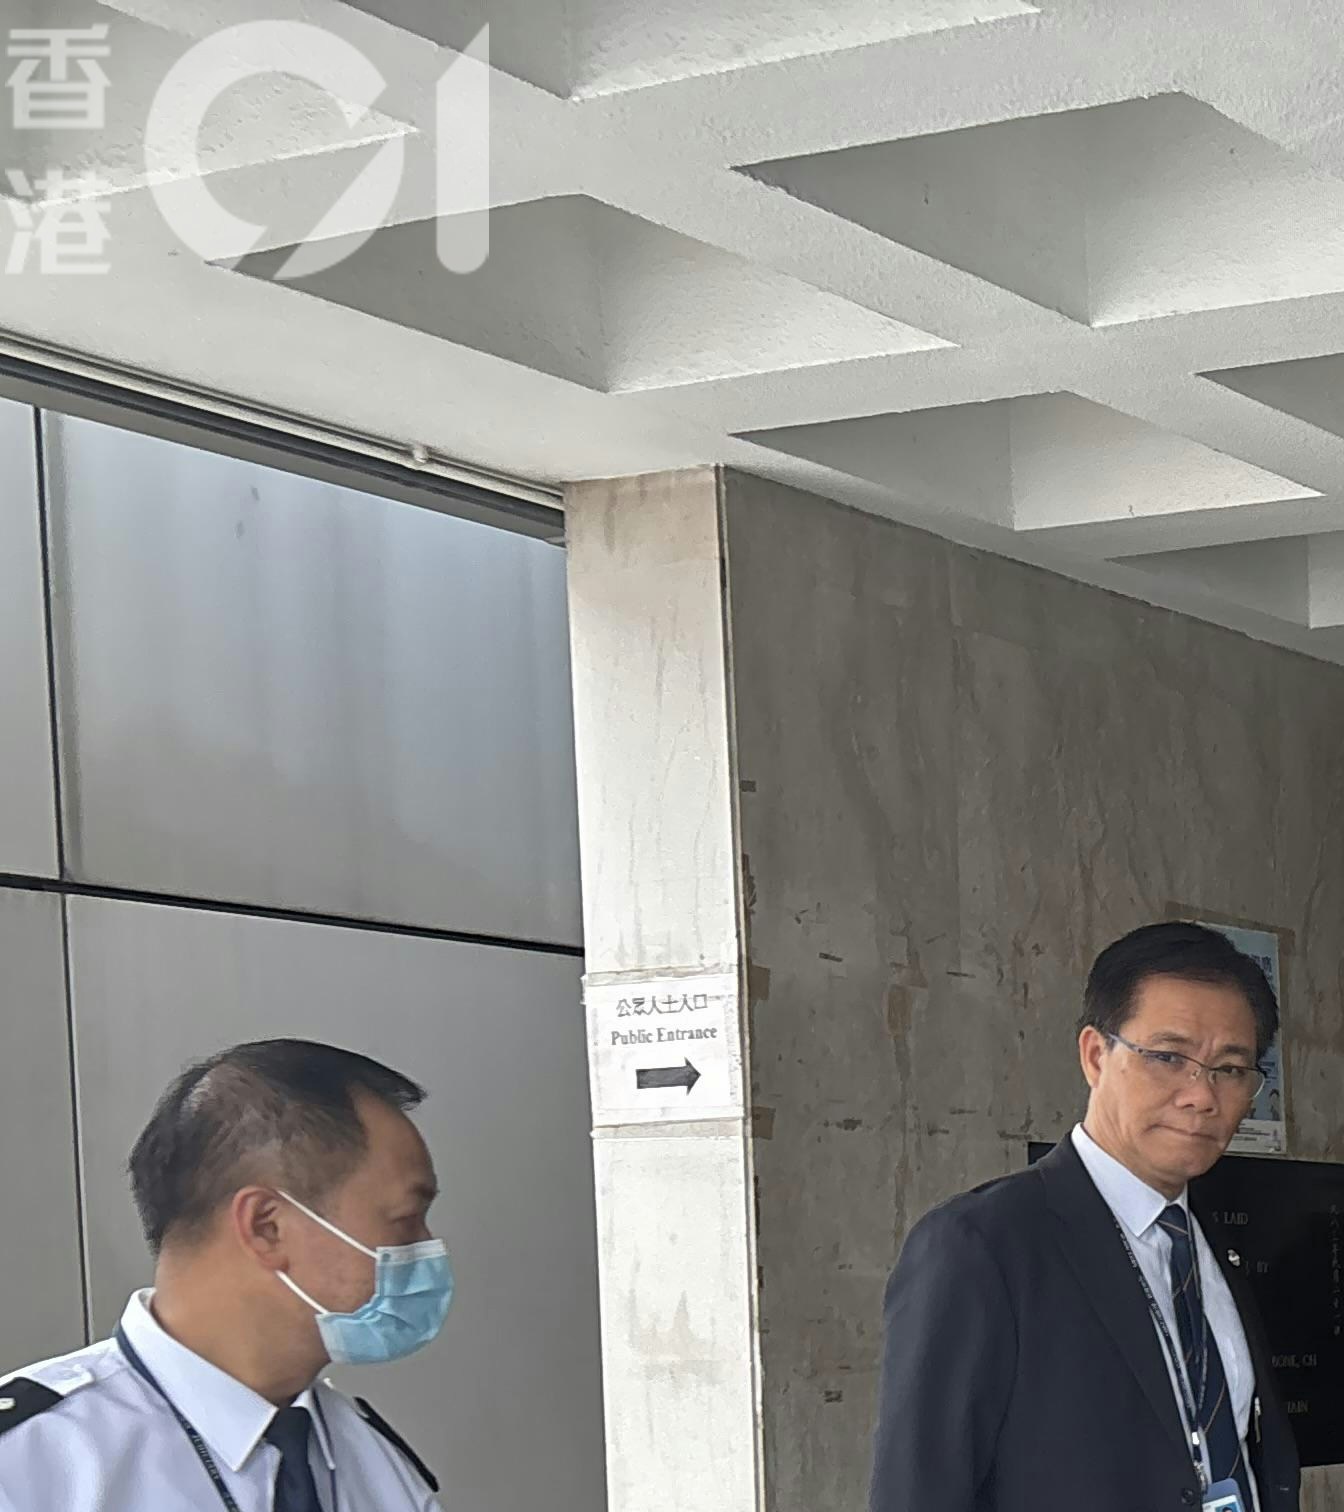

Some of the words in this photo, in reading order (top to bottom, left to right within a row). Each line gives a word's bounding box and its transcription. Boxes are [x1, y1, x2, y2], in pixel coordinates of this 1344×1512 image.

[611, 1029, 653, 1046] Public
[656, 1027, 718, 1043] Entrance
[1224, 1211, 1249, 1225] LAID
